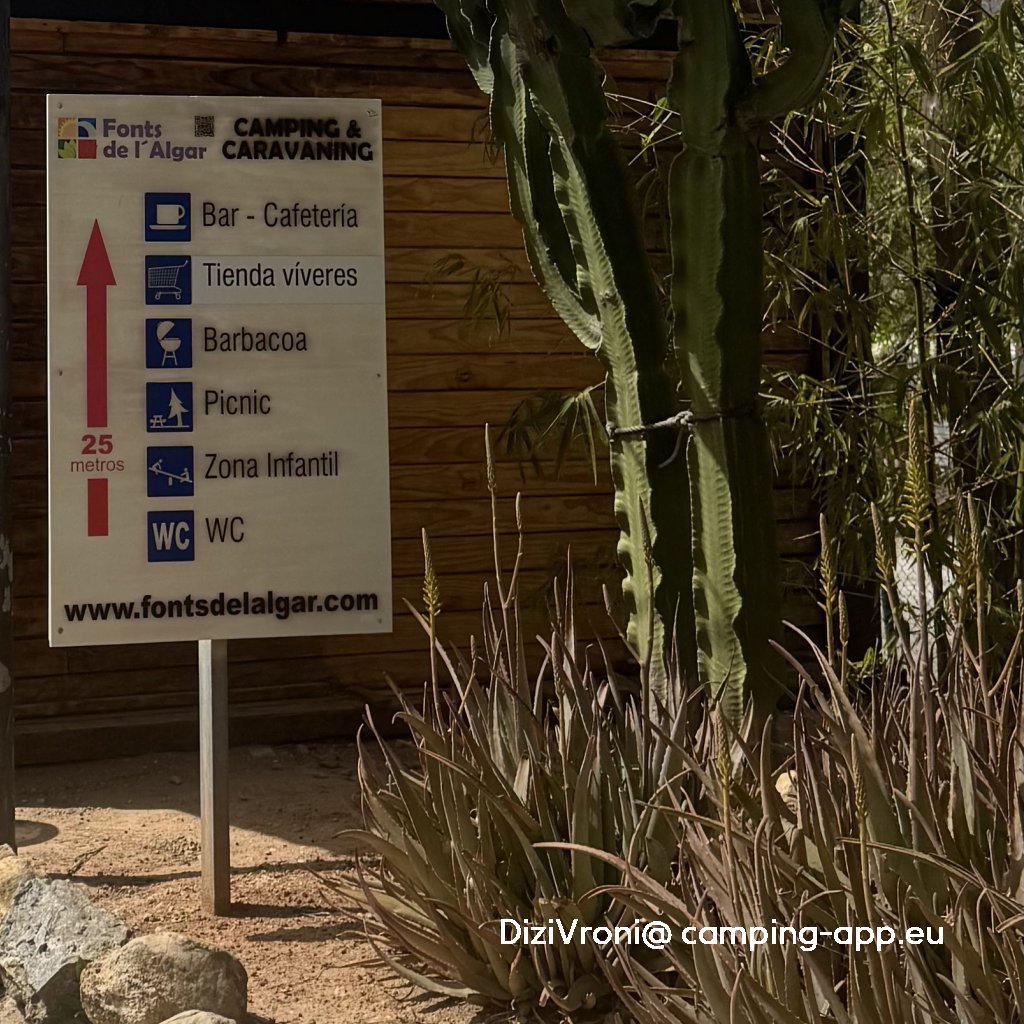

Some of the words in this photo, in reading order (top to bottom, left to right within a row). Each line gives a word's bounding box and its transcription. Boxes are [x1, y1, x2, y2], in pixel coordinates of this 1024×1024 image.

[102, 118, 162, 138] Fonts
[233, 117, 340, 139] CAMPING
[346, 120, 362, 139] &
[103, 140, 131, 159] de
[222, 140, 374, 162] CARAVANING
[202, 203, 239, 227] Bar
[264, 202, 358, 228] Cafetería
[203, 262, 275, 287] Tienda
[283, 262, 358, 287] víveres
[203, 327, 308, 352] Barbacoa
[204, 389, 271, 416] Picnic
[81, 434, 113, 455] 25
[70, 457, 125, 473] metros
[204, 454, 259, 479] Zona
[267, 451, 339, 477] Infantil
[152, 521, 190, 551] WC
[205, 516, 245, 543] WC
[64, 591, 379, 622] www.fontsdelalgar.com
